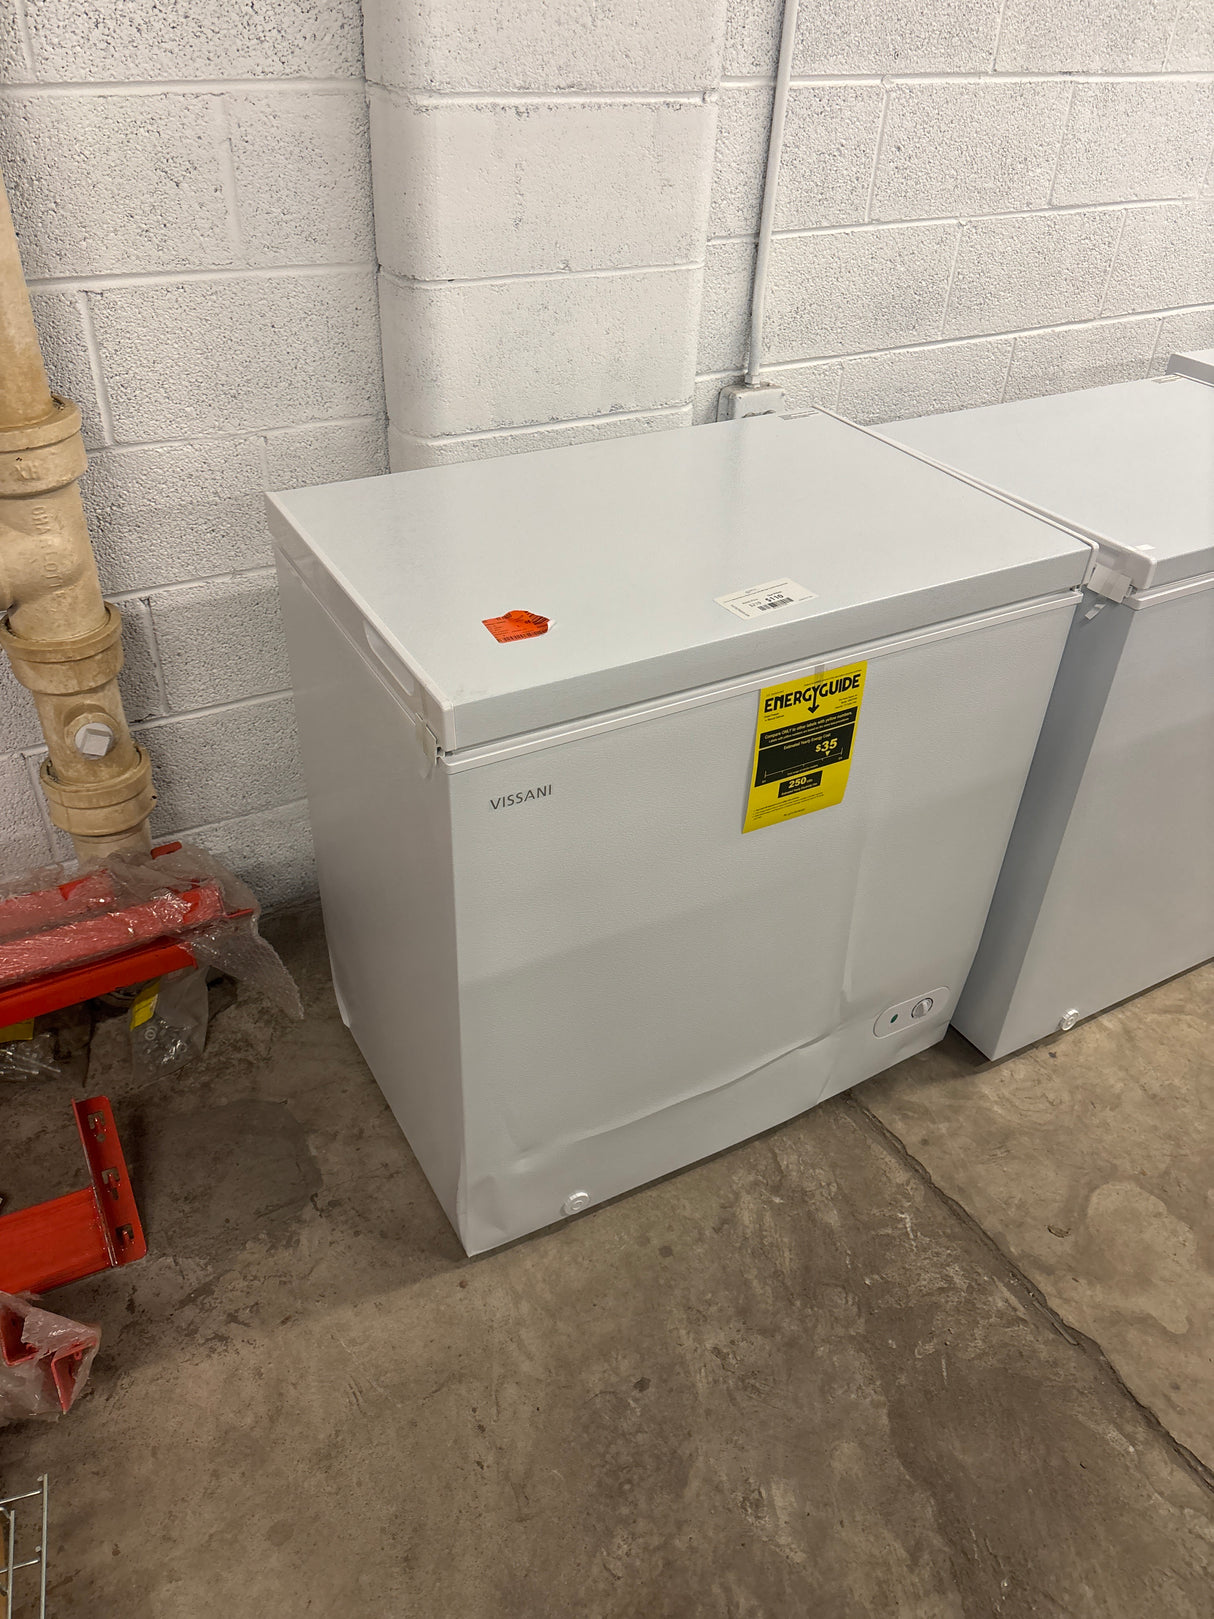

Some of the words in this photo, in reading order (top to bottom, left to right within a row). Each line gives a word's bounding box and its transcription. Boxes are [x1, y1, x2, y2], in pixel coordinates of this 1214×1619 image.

[764, 673, 861, 713] ENERGYGUIDE
[815, 738, 838, 753] $35
[788, 776, 807, 789] 250
[490, 784, 552, 810] VISSANI
